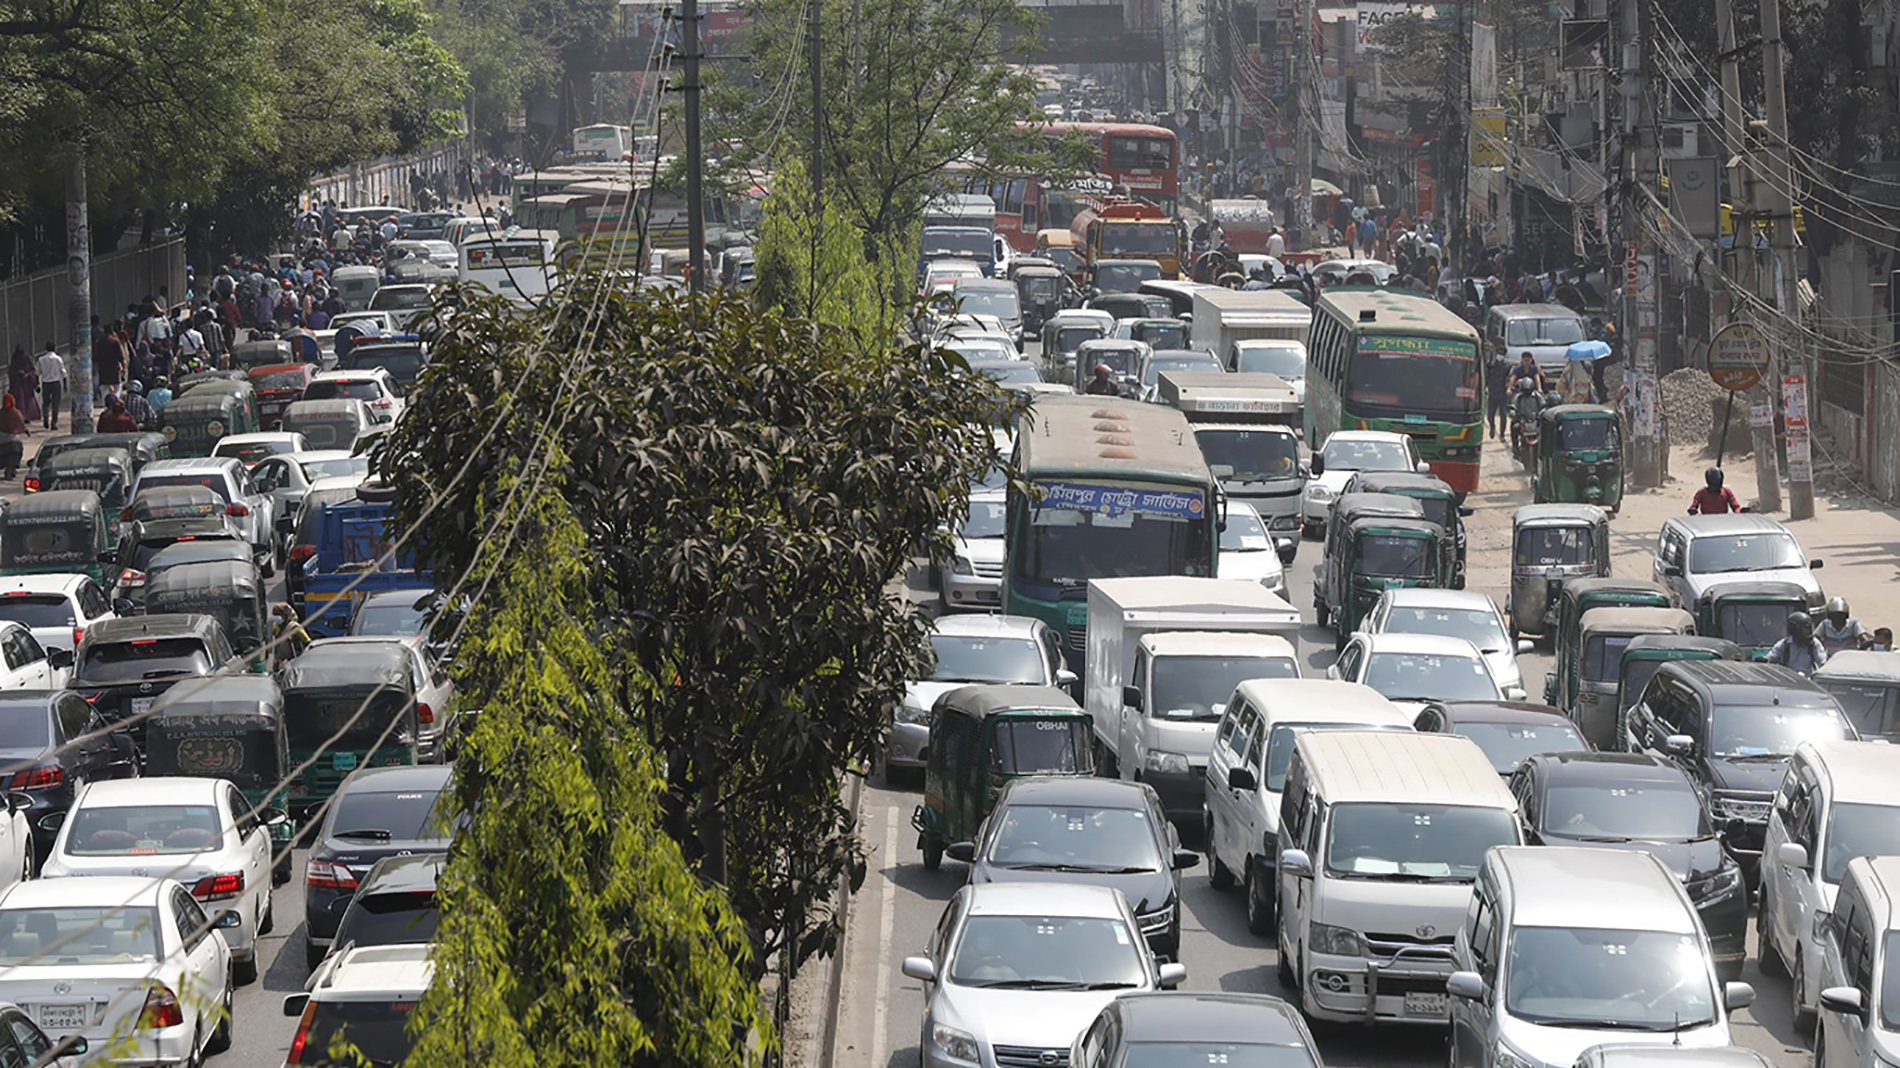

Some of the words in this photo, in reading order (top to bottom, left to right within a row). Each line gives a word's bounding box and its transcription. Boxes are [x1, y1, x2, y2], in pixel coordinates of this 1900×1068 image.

[1049, 484, 1096, 503] মিরপুর
[1101, 490, 1138, 507] মেট্রো
[1142, 493, 1191, 509] সার্ভিস
[1036, 721, 1068, 730] OBHAI
